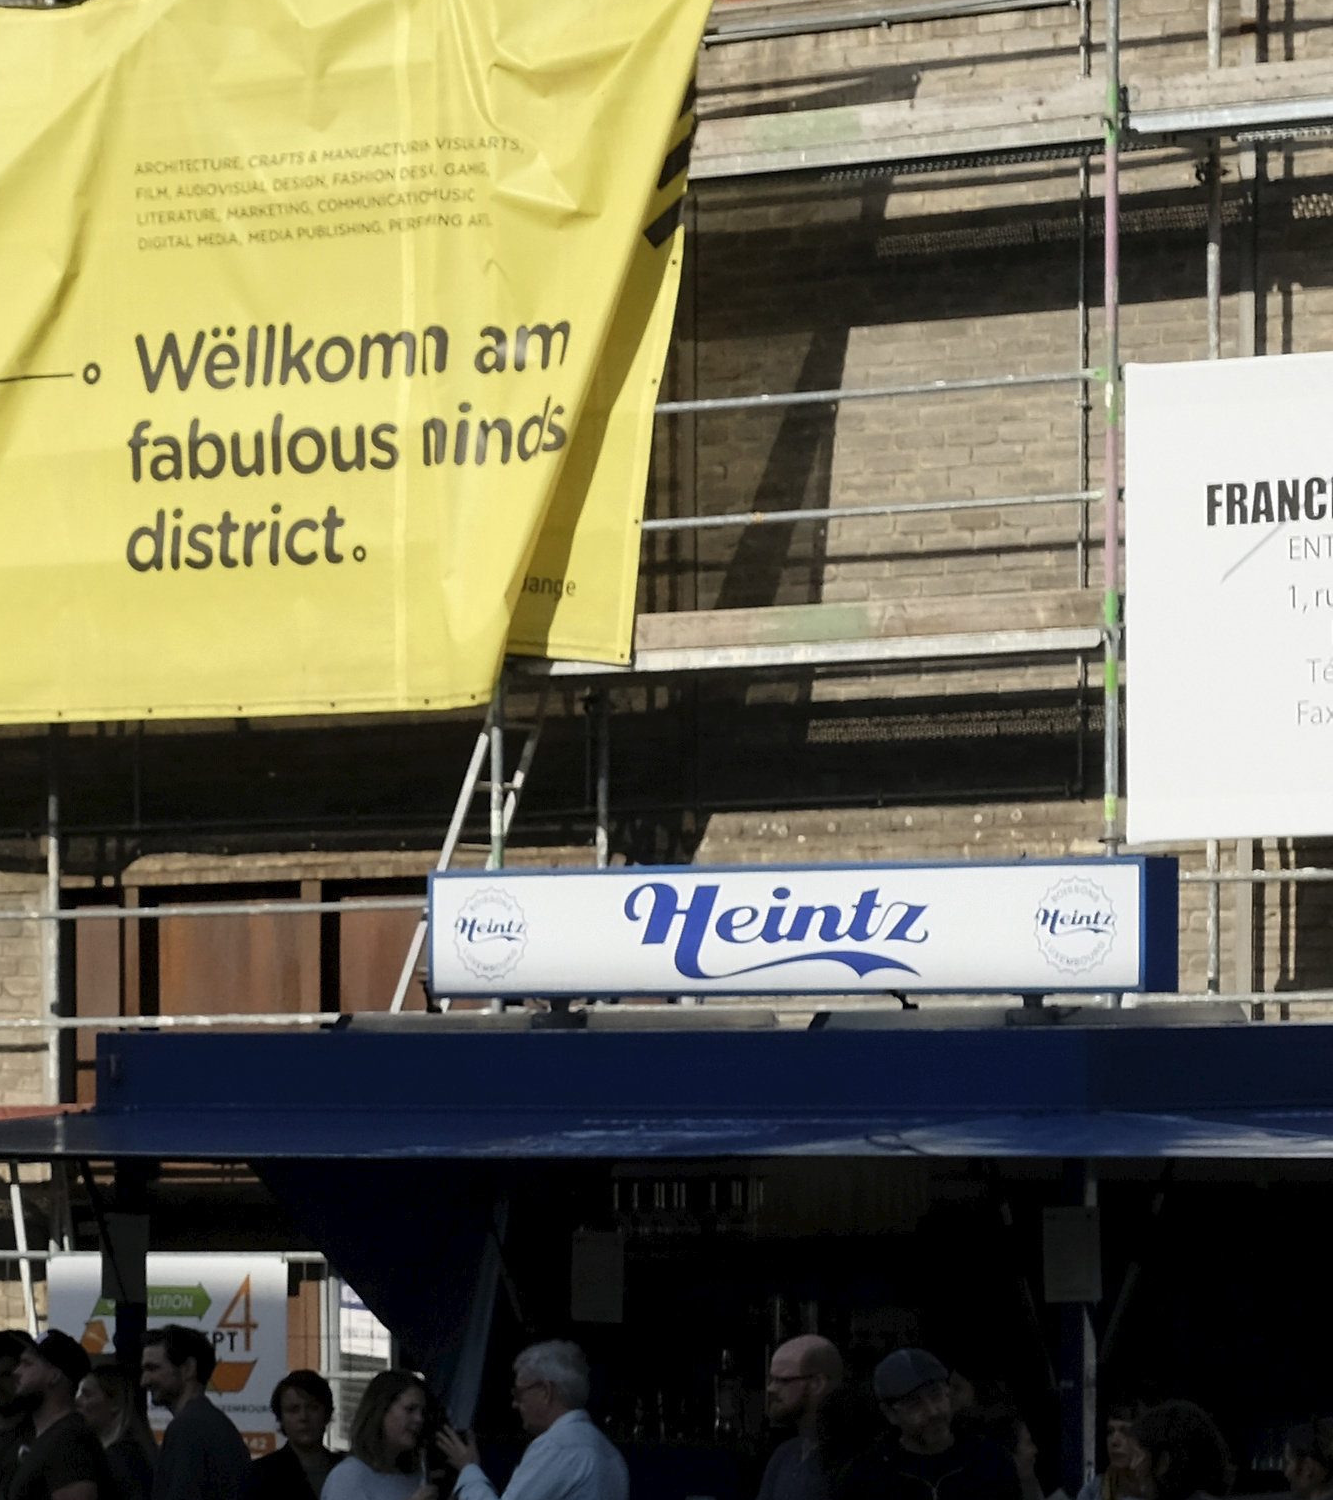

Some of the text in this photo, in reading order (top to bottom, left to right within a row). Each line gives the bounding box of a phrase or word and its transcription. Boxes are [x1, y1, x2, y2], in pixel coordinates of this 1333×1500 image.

[248, 151, 305, 168] CRAFTS
[475, 320, 571, 374] am
[128, 412, 400, 483] fabulous
[1206, 477, 1333, 526] FRANC
[624, 882, 929, 979] Heintz
[1035, 907, 1115, 936] Heintz
[216, 1273, 259, 1352] 4
